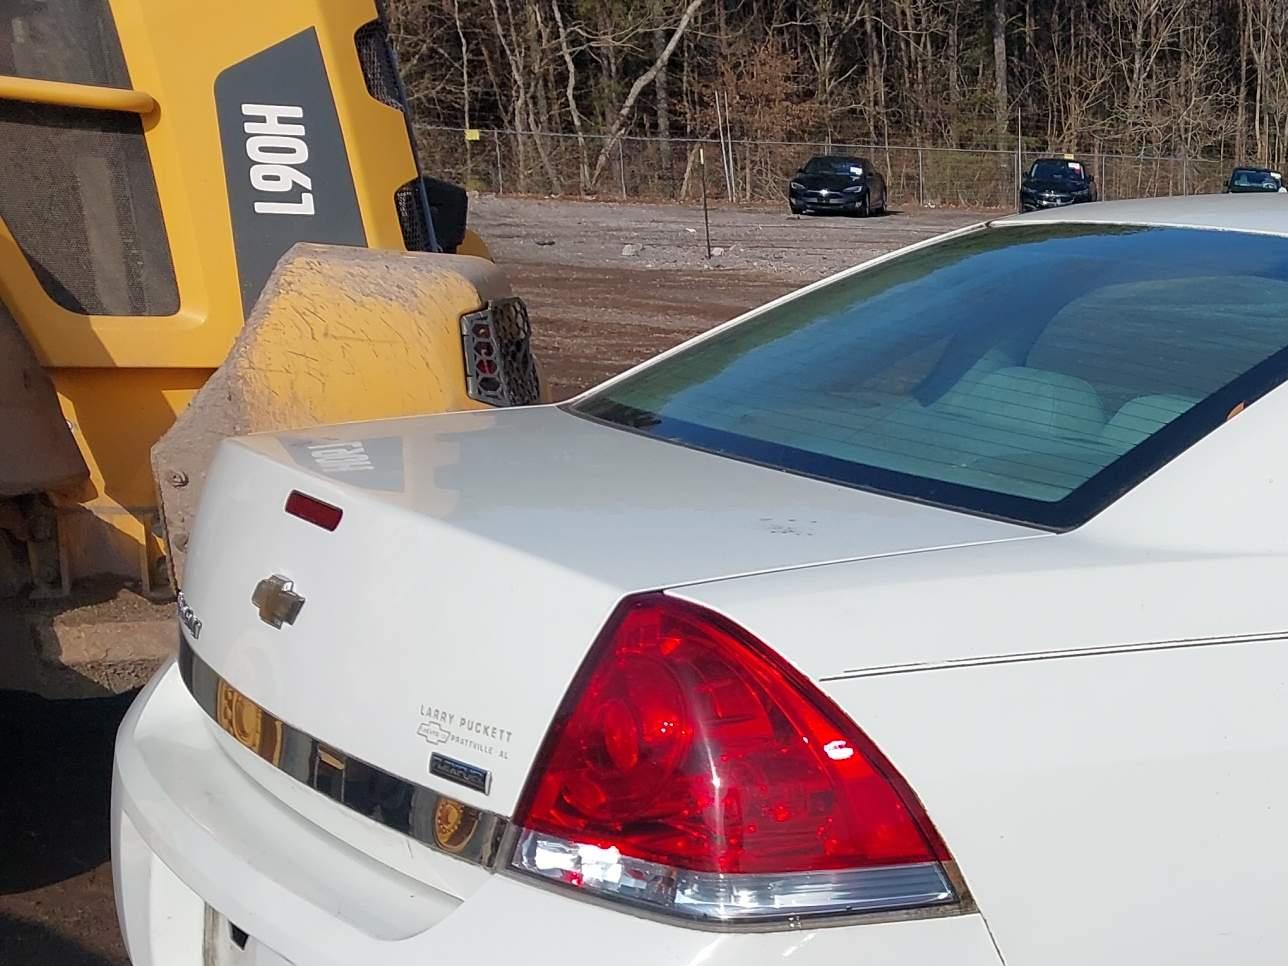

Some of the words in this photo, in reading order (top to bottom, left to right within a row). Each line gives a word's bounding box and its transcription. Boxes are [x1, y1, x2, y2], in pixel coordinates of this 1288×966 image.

[241, 103, 315, 215] L90H
[420, 703, 455, 724] LARRY
[459, 717, 513, 743] PUCKETT
